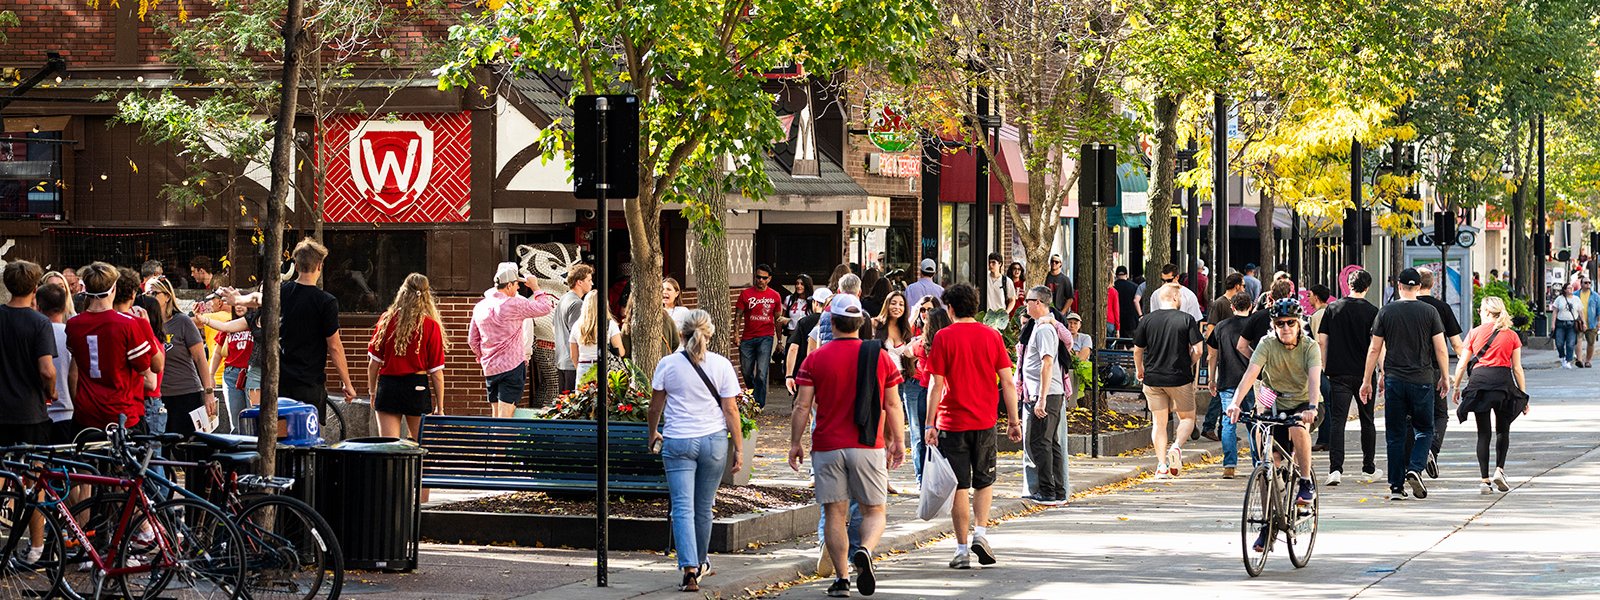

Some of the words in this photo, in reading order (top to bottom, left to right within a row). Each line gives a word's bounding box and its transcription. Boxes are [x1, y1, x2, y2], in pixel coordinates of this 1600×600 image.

[361, 138, 419, 193] W
[86, 335, 102, 379] 1
[57, 503, 92, 552] cannondale
